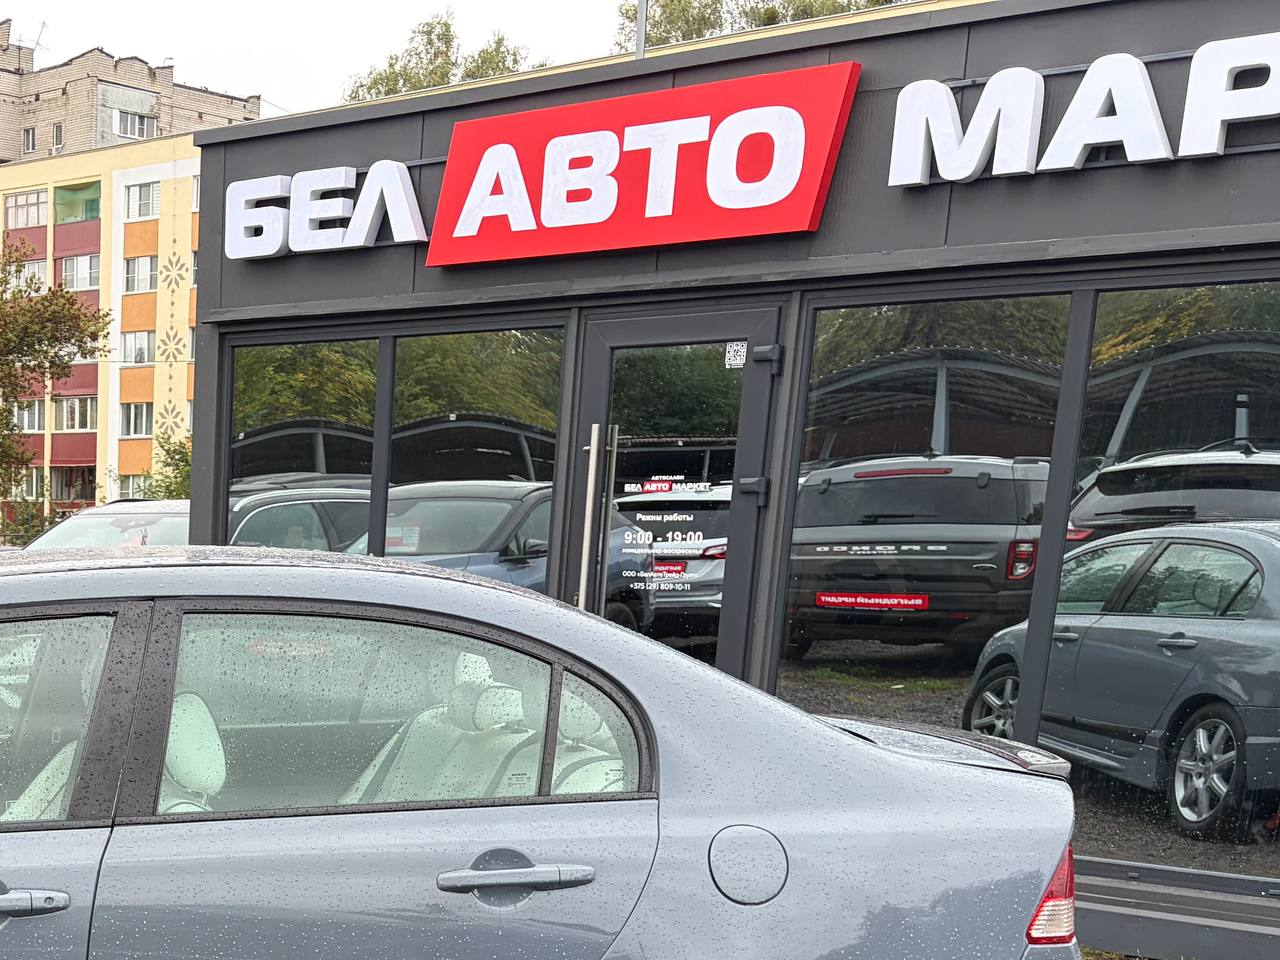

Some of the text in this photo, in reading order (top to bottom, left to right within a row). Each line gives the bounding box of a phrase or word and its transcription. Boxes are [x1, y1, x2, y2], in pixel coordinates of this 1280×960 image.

[225, 32, 1280, 260] БЕЛ АВТО МАР
[624, 482, 712, 493] БЕЛ АВТО МАРКЕТ
[636, 512, 694, 523] Режим работы
[624, 531, 654, 544] 9:00
[665, 531, 704, 544] 19:00
[622, 570, 637, 578] ООО
[629, 582, 691, 591] +375 (29) 809-10-11
